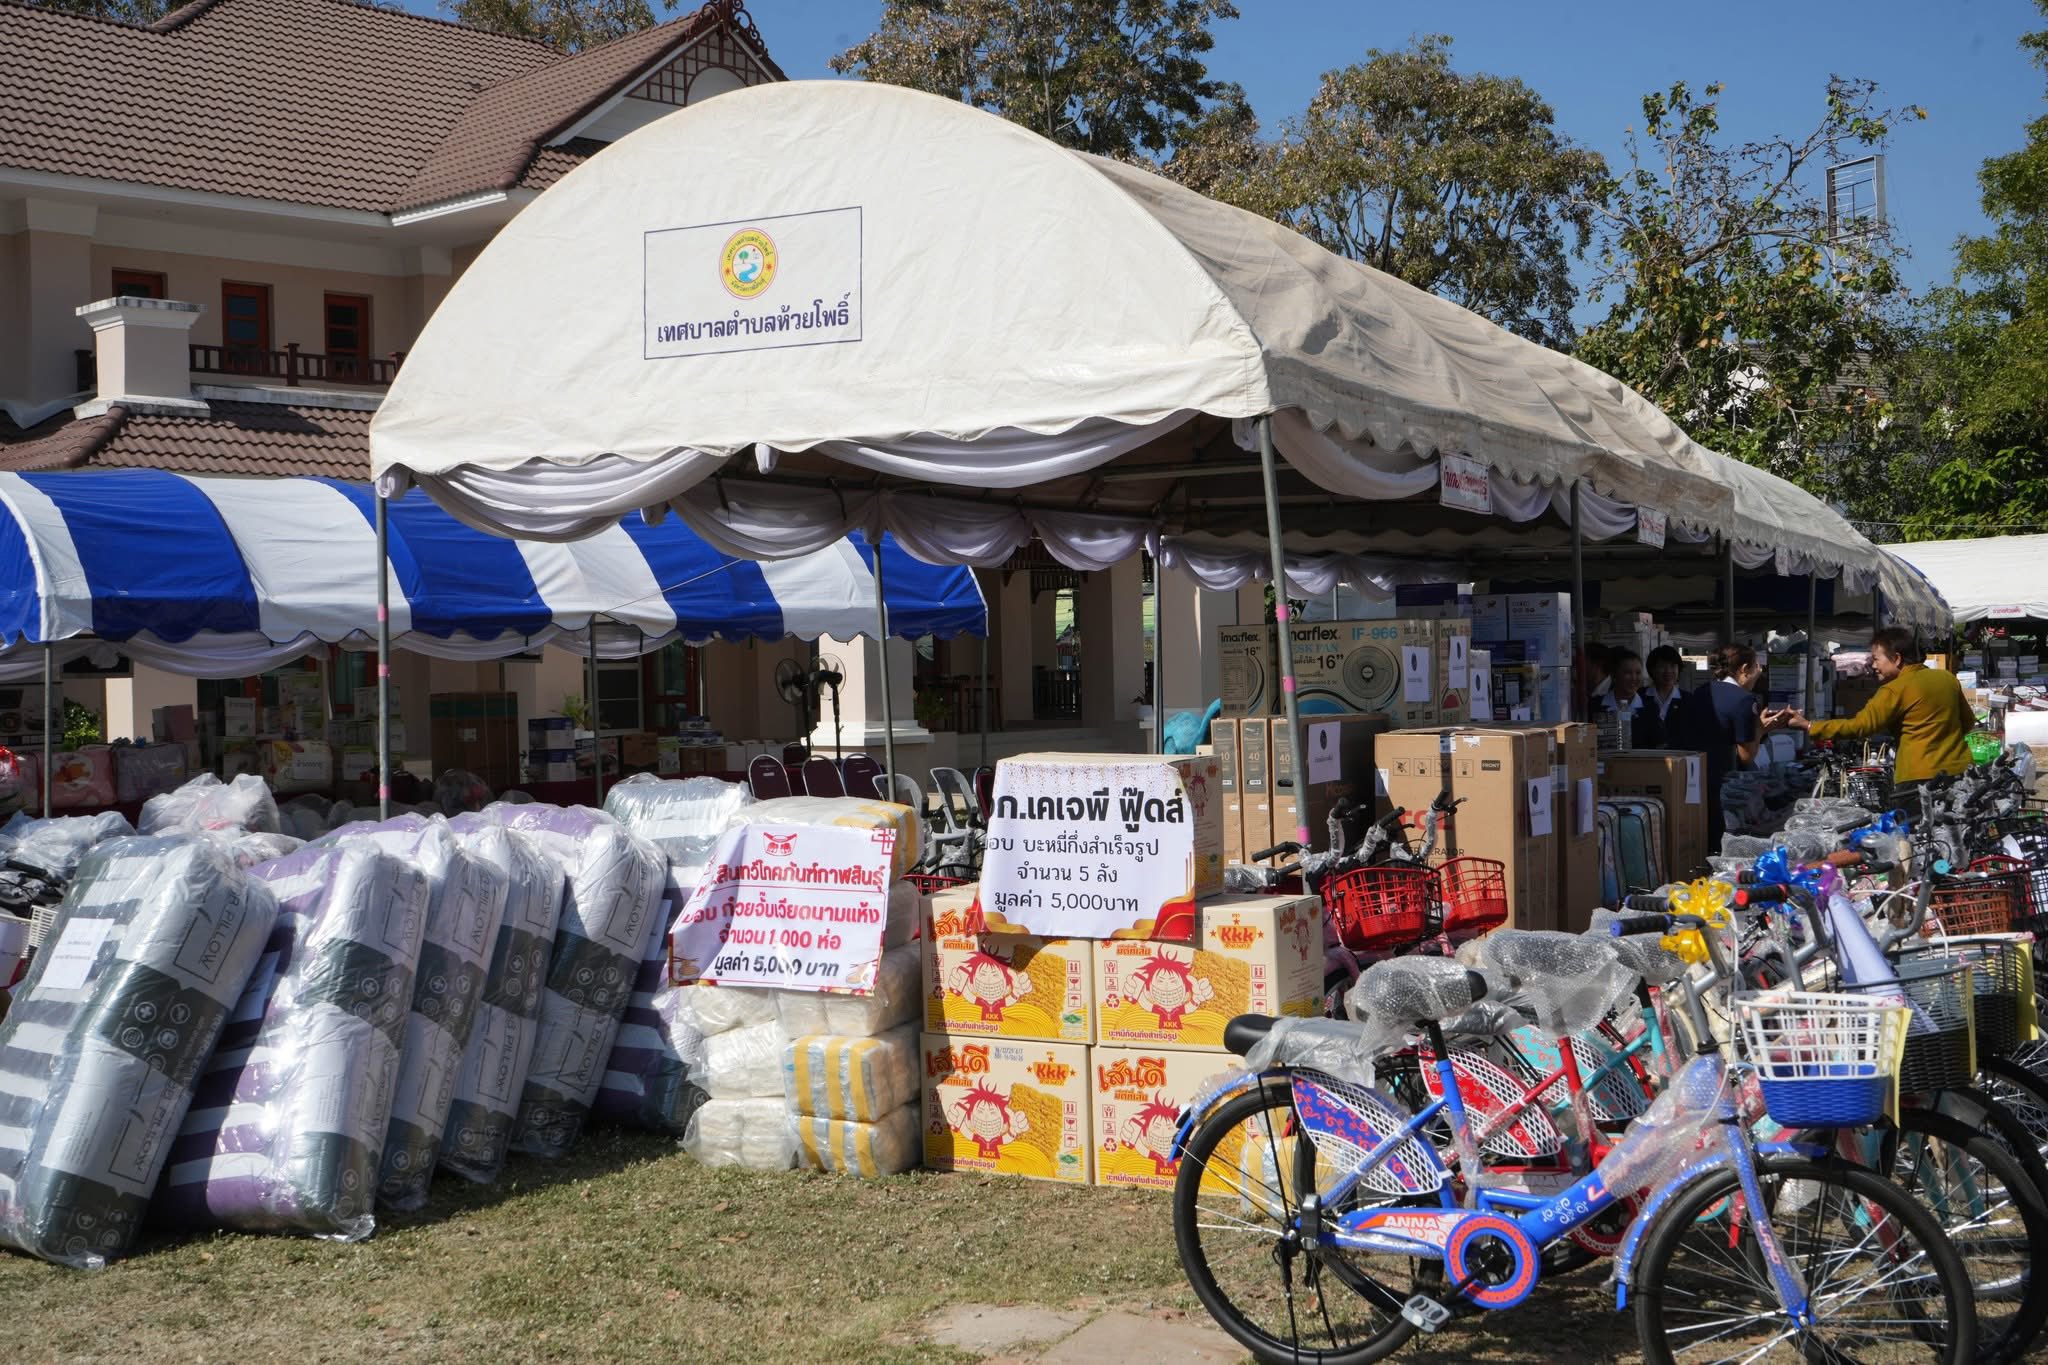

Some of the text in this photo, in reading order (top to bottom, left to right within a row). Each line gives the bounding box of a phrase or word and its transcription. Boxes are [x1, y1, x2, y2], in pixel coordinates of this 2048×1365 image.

[657, 292, 851, 343] เทศบาลตำบลห้วยโพธิ์
[1290, 626, 1339, 641] marflex
[1248, 751, 1260, 761] 40
[1279, 754, 1291, 764] 40
[1481, 761, 1500, 770] FRONT
[985, 829, 1160, 862] อบ บะหมี่กึ่งสำเร็จรูป
[1017, 862, 1118, 883] จำนวน 5 ลัง
[994, 888, 1043, 912] มูลค่า
[200, 908, 235, 971] PILLOW
[718, 922, 842, 950] จำนวน 1000 ห่อ
[714, 950, 750, 977] มูลค่า
[805, 961, 840, 977] บาท
[985, 1013, 999, 1021] KKK
[497, 1036, 515, 1092] PILLOW
[576, 1028, 603, 1082] PILLOW
[1097, 1055, 1167, 1092] เส้นดี
[1159, 1167, 1175, 1175] KKK
[1383, 1215, 1439, 1230] ANNA
